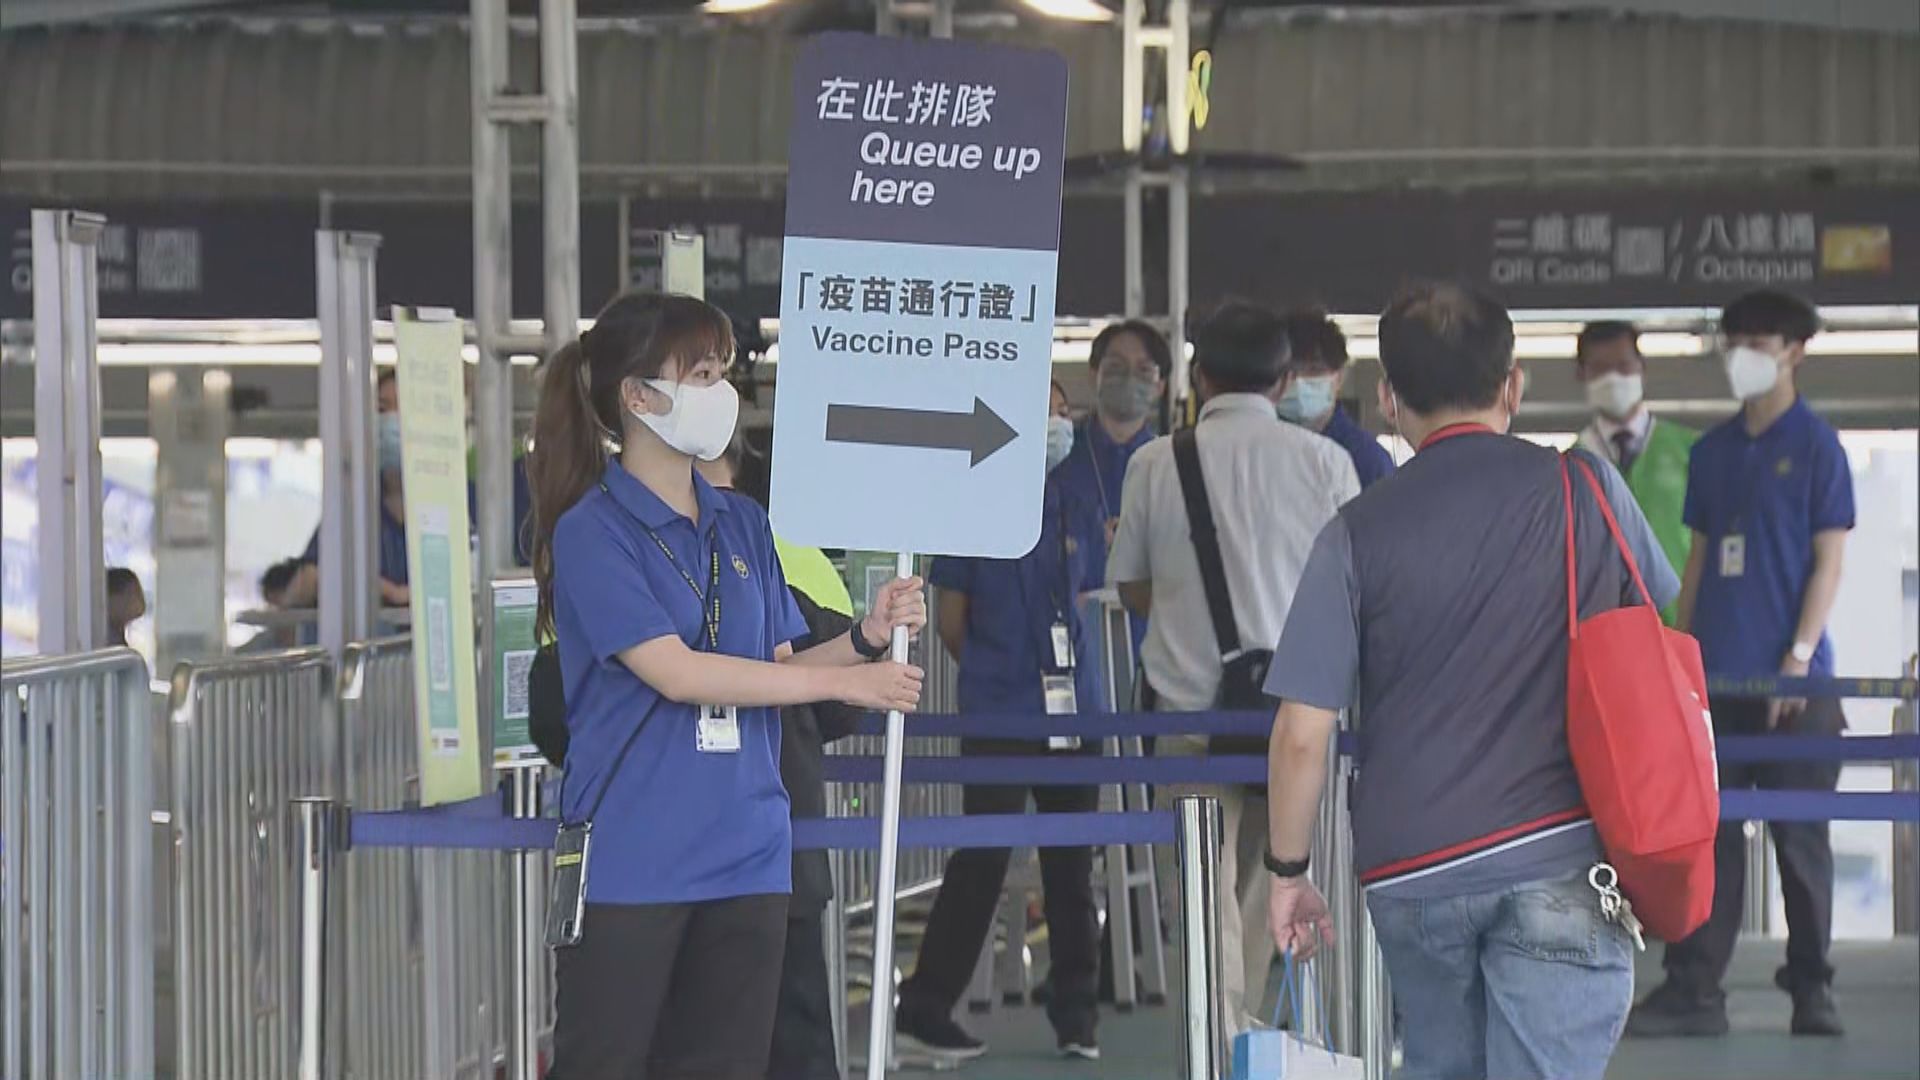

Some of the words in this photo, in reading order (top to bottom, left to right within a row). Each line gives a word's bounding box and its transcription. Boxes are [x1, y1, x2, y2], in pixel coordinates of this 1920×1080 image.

[816, 77, 996, 128] 在此排隊
[860, 131, 983, 170] Queue
[992, 145, 1041, 180] up
[850, 170, 936, 206] here
[1696, 256, 1814, 285] Octopus
[797, 271, 1037, 323] 「疫苗通行證」
[811, 325, 933, 358] Vaccine
[943, 332, 1019, 362] Pass
